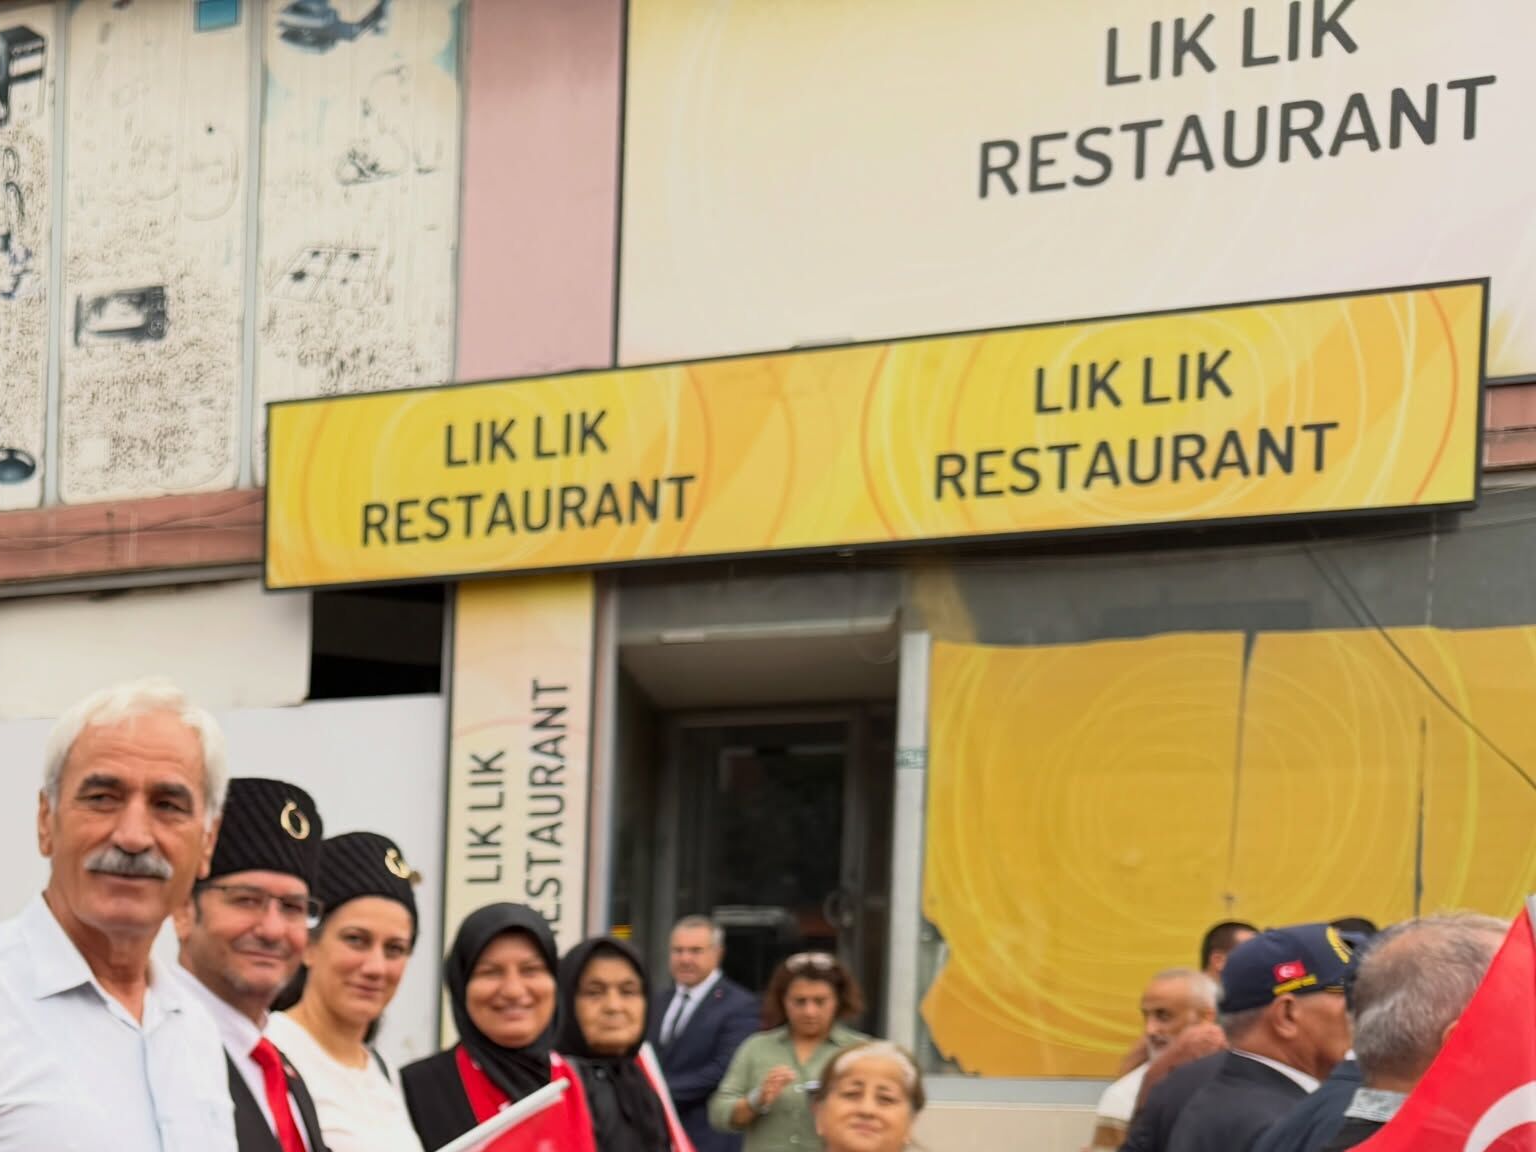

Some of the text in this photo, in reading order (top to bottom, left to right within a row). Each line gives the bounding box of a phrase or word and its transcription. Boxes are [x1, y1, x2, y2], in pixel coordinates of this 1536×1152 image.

[1106, 0, 1359, 86] LIK LIK
[978, 75, 1497, 200] RESTAURANT
[1034, 349, 1233, 414] LIK LIK
[445, 410, 608, 467] LIK LIK
[934, 422, 1340, 500] RESTAURANT
[362, 475, 696, 547] RESTAURANT
[466, 750, 505, 883] LIK LIK
[525, 679, 569, 933] ESTAURANT
